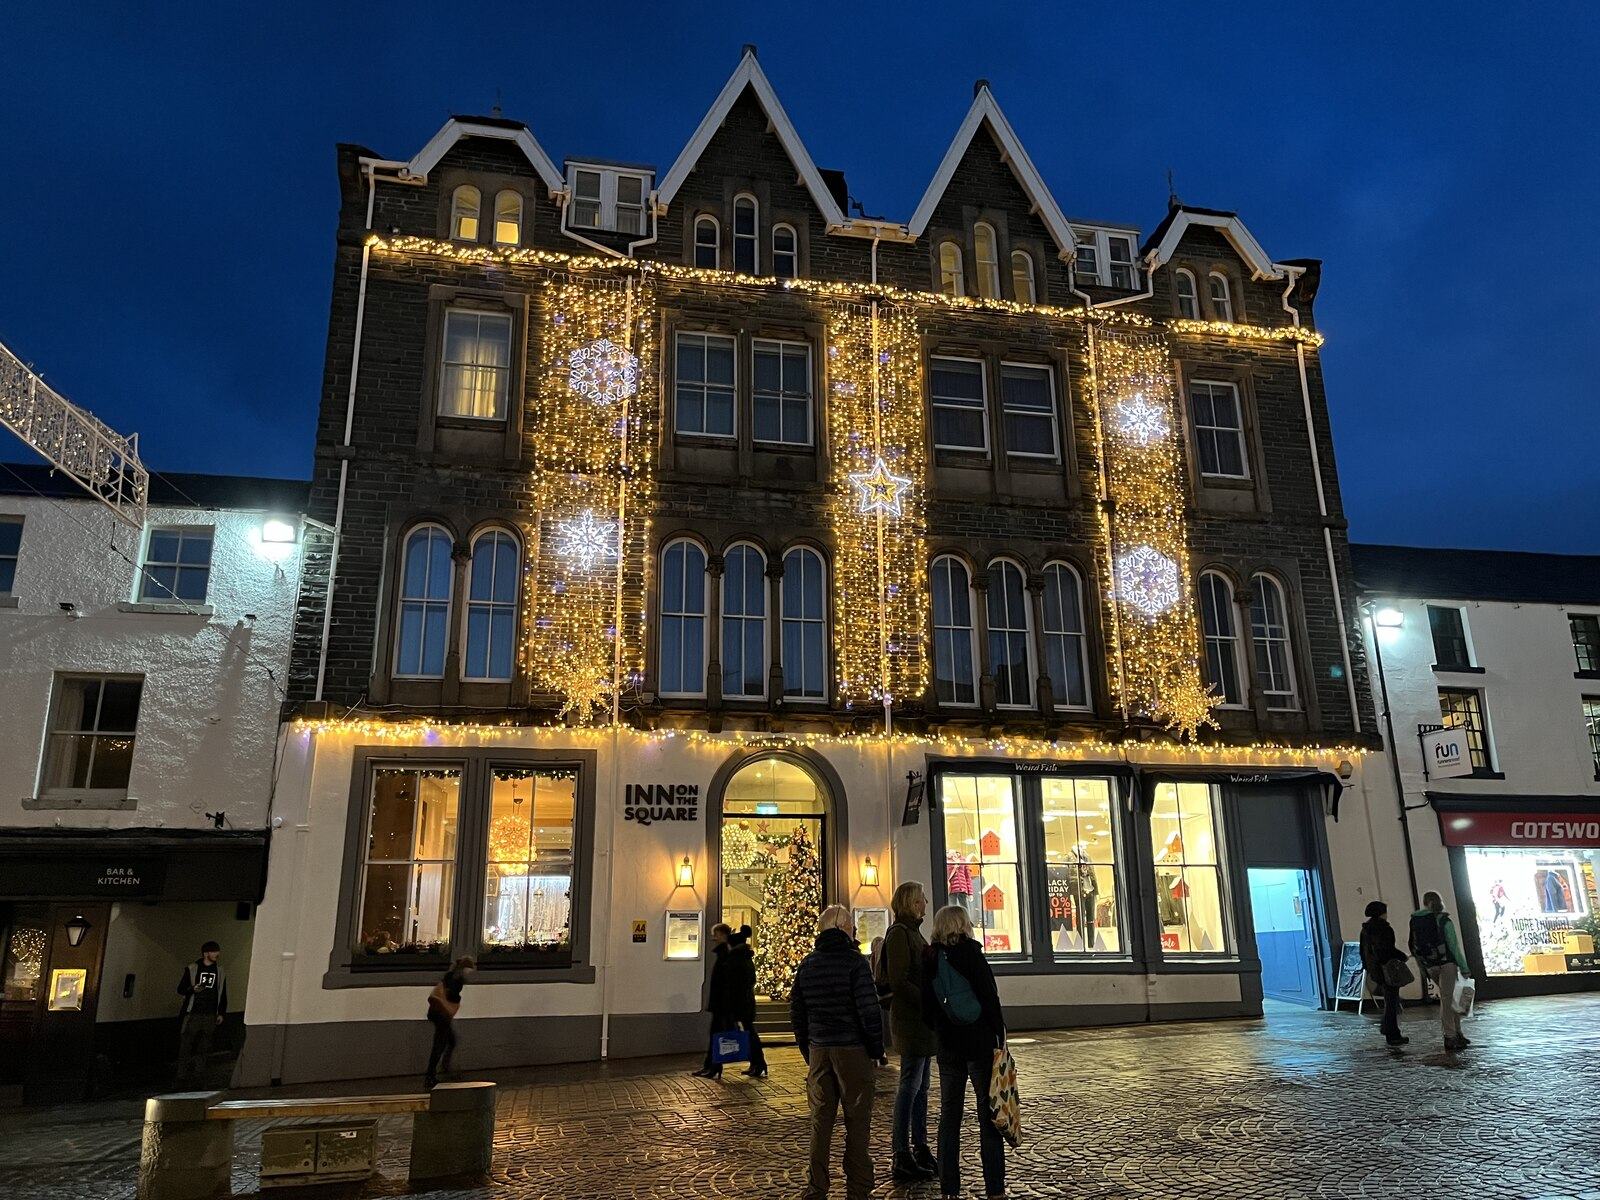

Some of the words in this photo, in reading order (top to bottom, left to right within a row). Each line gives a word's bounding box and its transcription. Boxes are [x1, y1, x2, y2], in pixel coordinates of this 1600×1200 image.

[1015, 763, 1040, 771] Weird
[1040, 763, 1058, 772] Fish
[625, 784, 675, 805] INN
[676, 784, 699, 796] ON
[676, 796, 698, 806] THE
[624, 806, 698, 826] SQUARE
[1511, 821, 1600, 839] COTSWO
[106, 868, 125, 876] BAR
[127, 868, 134, 876] &
[97, 877, 140, 885] KITCHEN
[1050, 896, 1071, 908] 0%
[635, 924, 646, 933] AA
